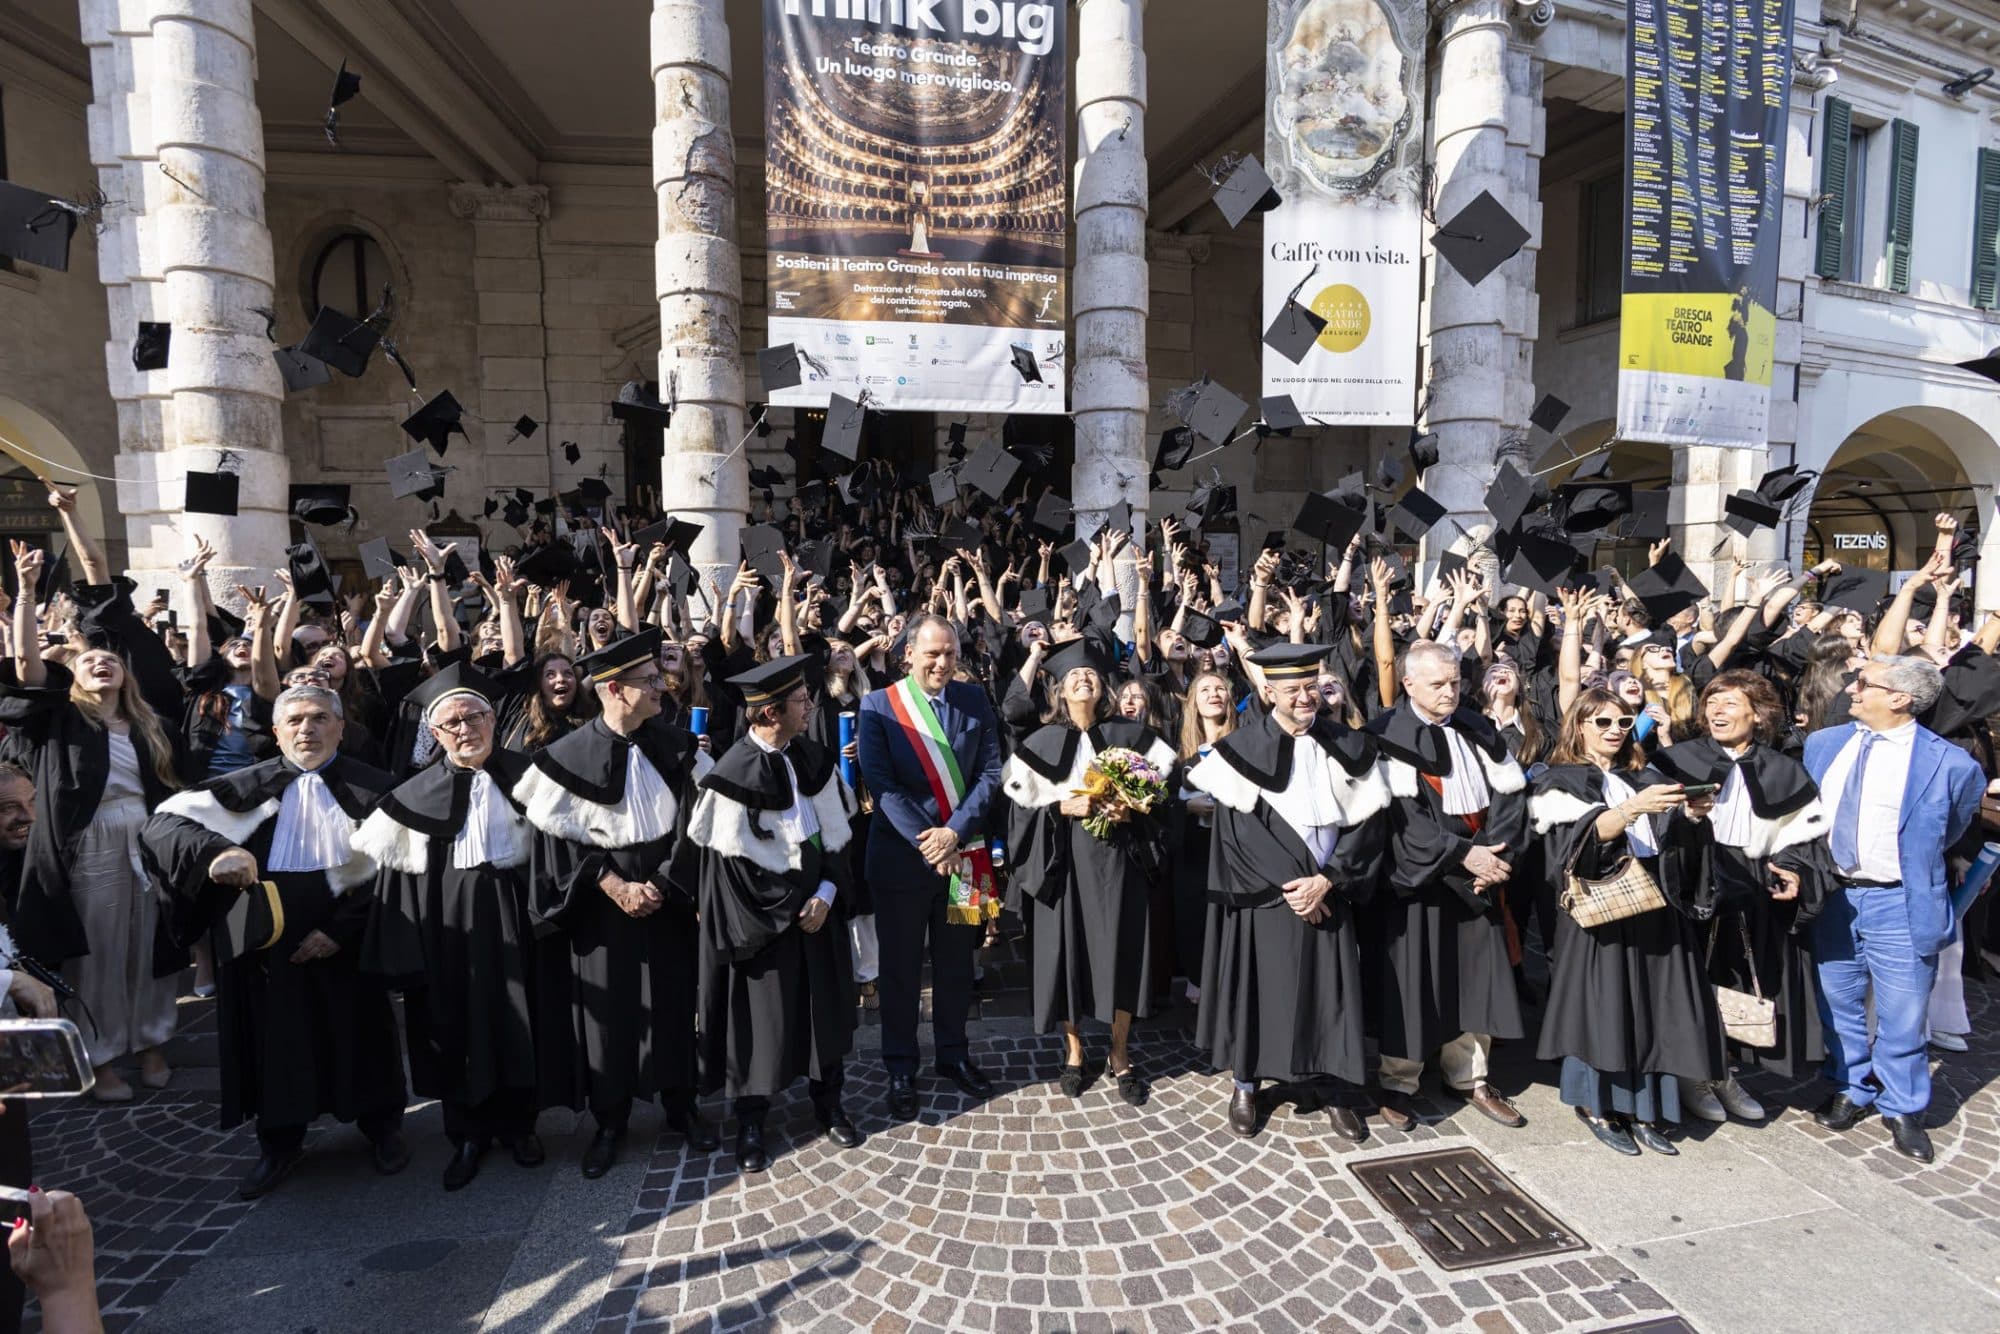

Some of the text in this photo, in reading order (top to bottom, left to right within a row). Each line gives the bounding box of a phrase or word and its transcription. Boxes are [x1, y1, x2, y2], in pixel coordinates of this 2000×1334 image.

[851, 37, 982, 67] Teatro Grande.
[816, 57, 1017, 94] Un luogo meraviglioso.
[1271, 241, 1410, 265] Caffè con vista.
[776, 255, 1057, 285] Sostieni il Teatro Grande con la tua impresa
[853, 283, 987, 299] Detrazione d'imposta del 65%
[870, 295, 971, 310] del contributo erogato.
[1674, 307, 1713, 322] BRESCIA
[1326, 319, 1362, 329] RANDE
[1665, 318, 1702, 333] TEATRO
[1672, 332, 1713, 347] GRANDE
[1833, 531, 1888, 549] TEZENIS
